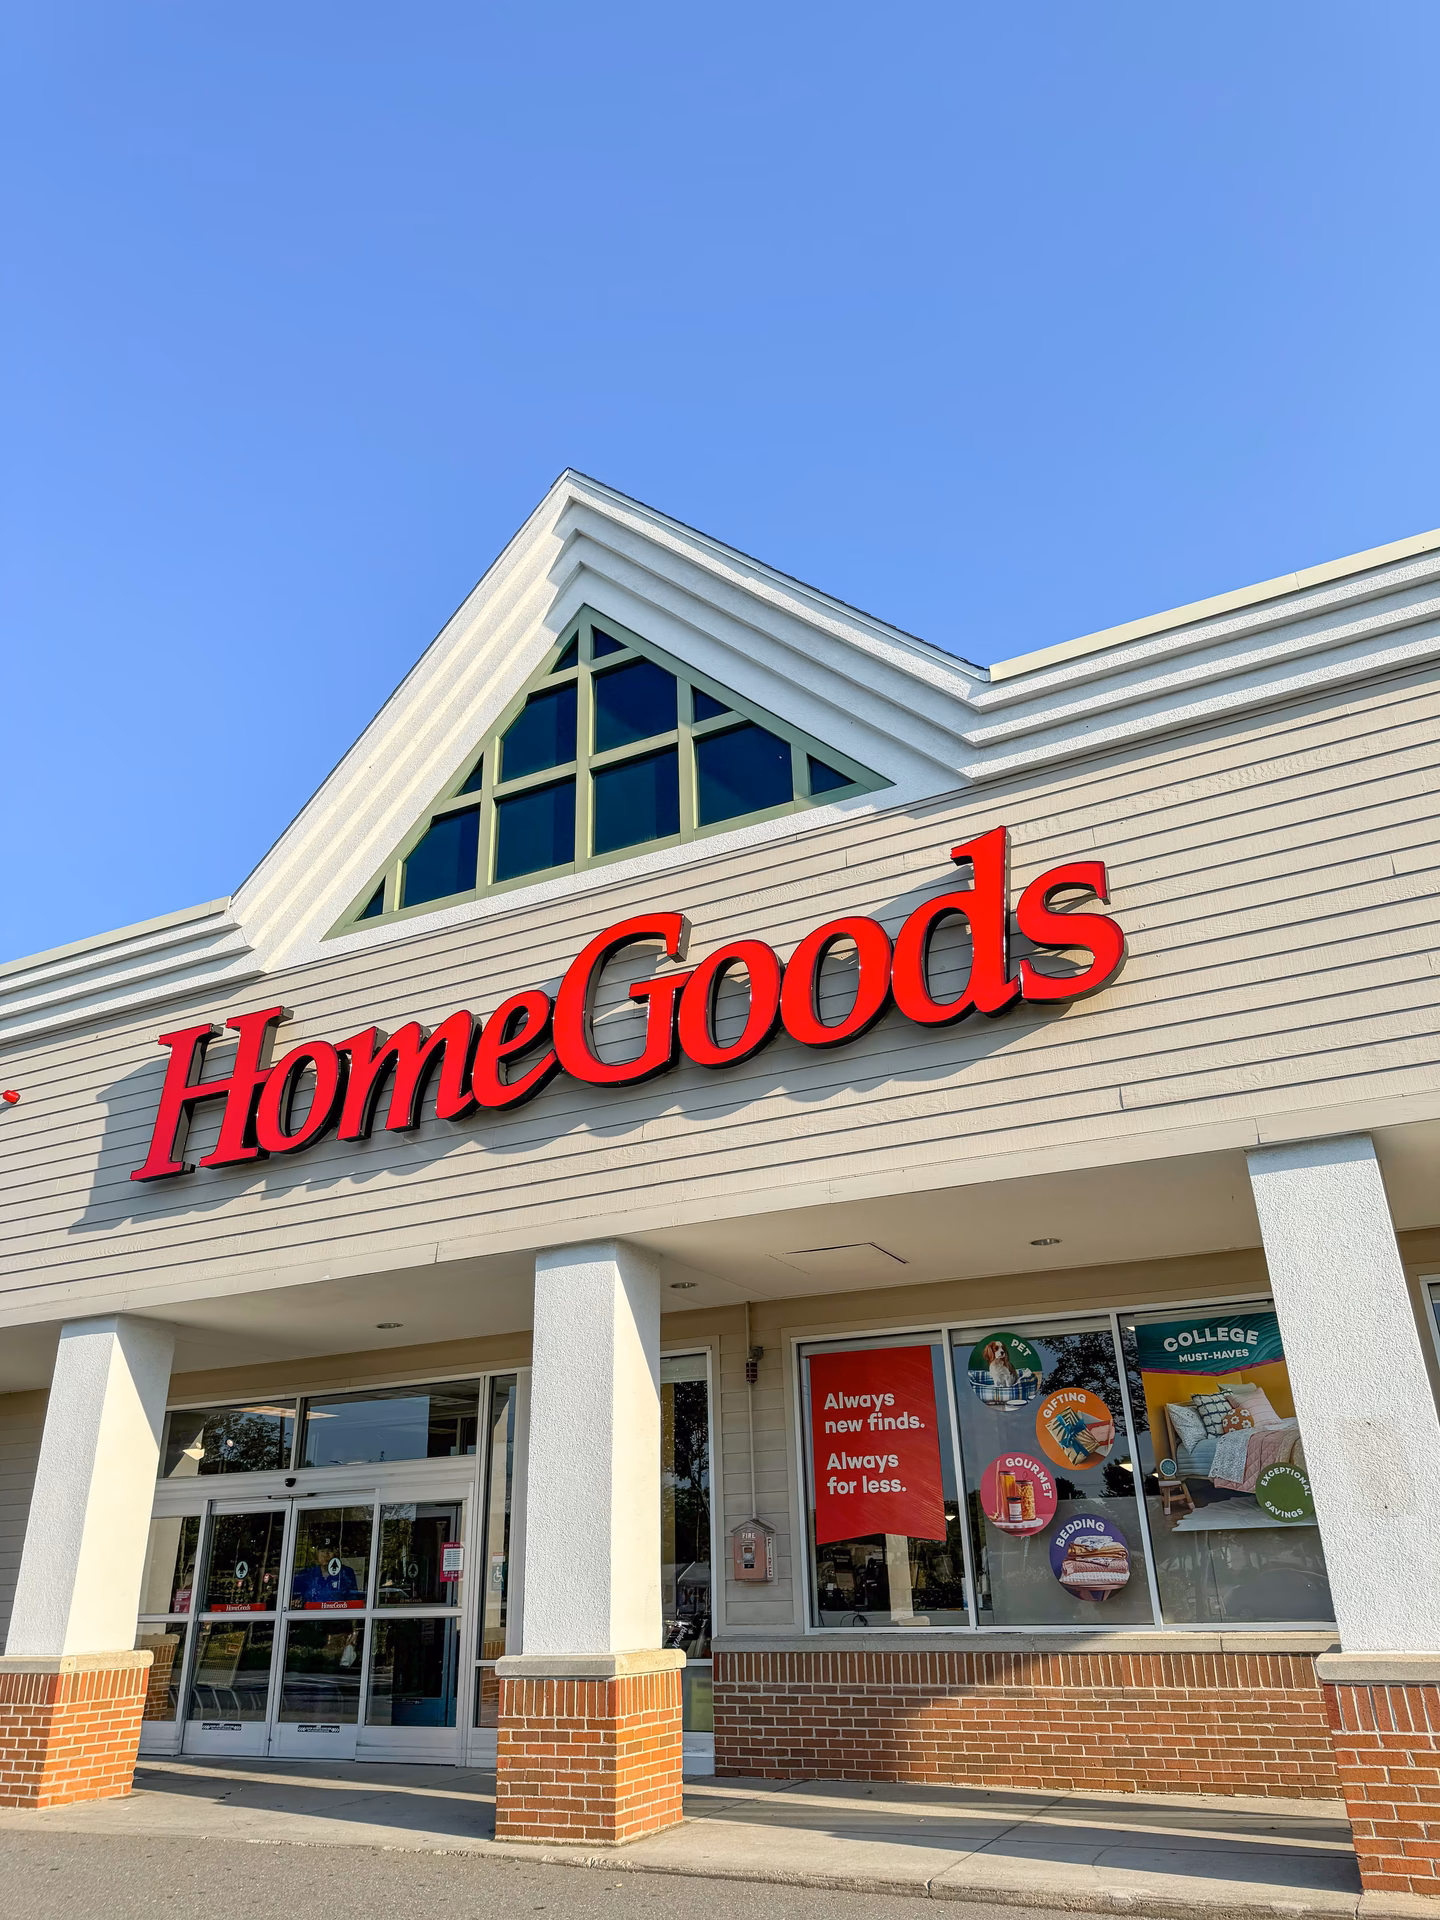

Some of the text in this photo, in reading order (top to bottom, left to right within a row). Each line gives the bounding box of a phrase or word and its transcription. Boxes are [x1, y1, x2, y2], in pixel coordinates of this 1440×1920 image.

[130, 825, 1126, 1181] HomeGoods
[1011, 1339, 1032, 1356] PET
[1163, 1327, 1259, 1352] COLLEGE
[1178, 1348, 1250, 1362] MUST-HAVES
[824, 1391, 895, 1412] Always
[1043, 1392, 1087, 1418] GIFTING
[825, 1411, 926, 1434] new finds.
[826, 1451, 899, 1474] Always
[827, 1475, 907, 1495] for less.
[1005, 1457, 1053, 1499] GOURMET
[1261, 1466, 1311, 1496] EXCEPTIONAL
[1265, 1501, 1304, 1518] SAVINGS
[1055, 1518, 1105, 1547] BEDDING
[225, 1603, 251, 1611] HomeGoods
[321, 1601, 348, 1609] HomeGoods
